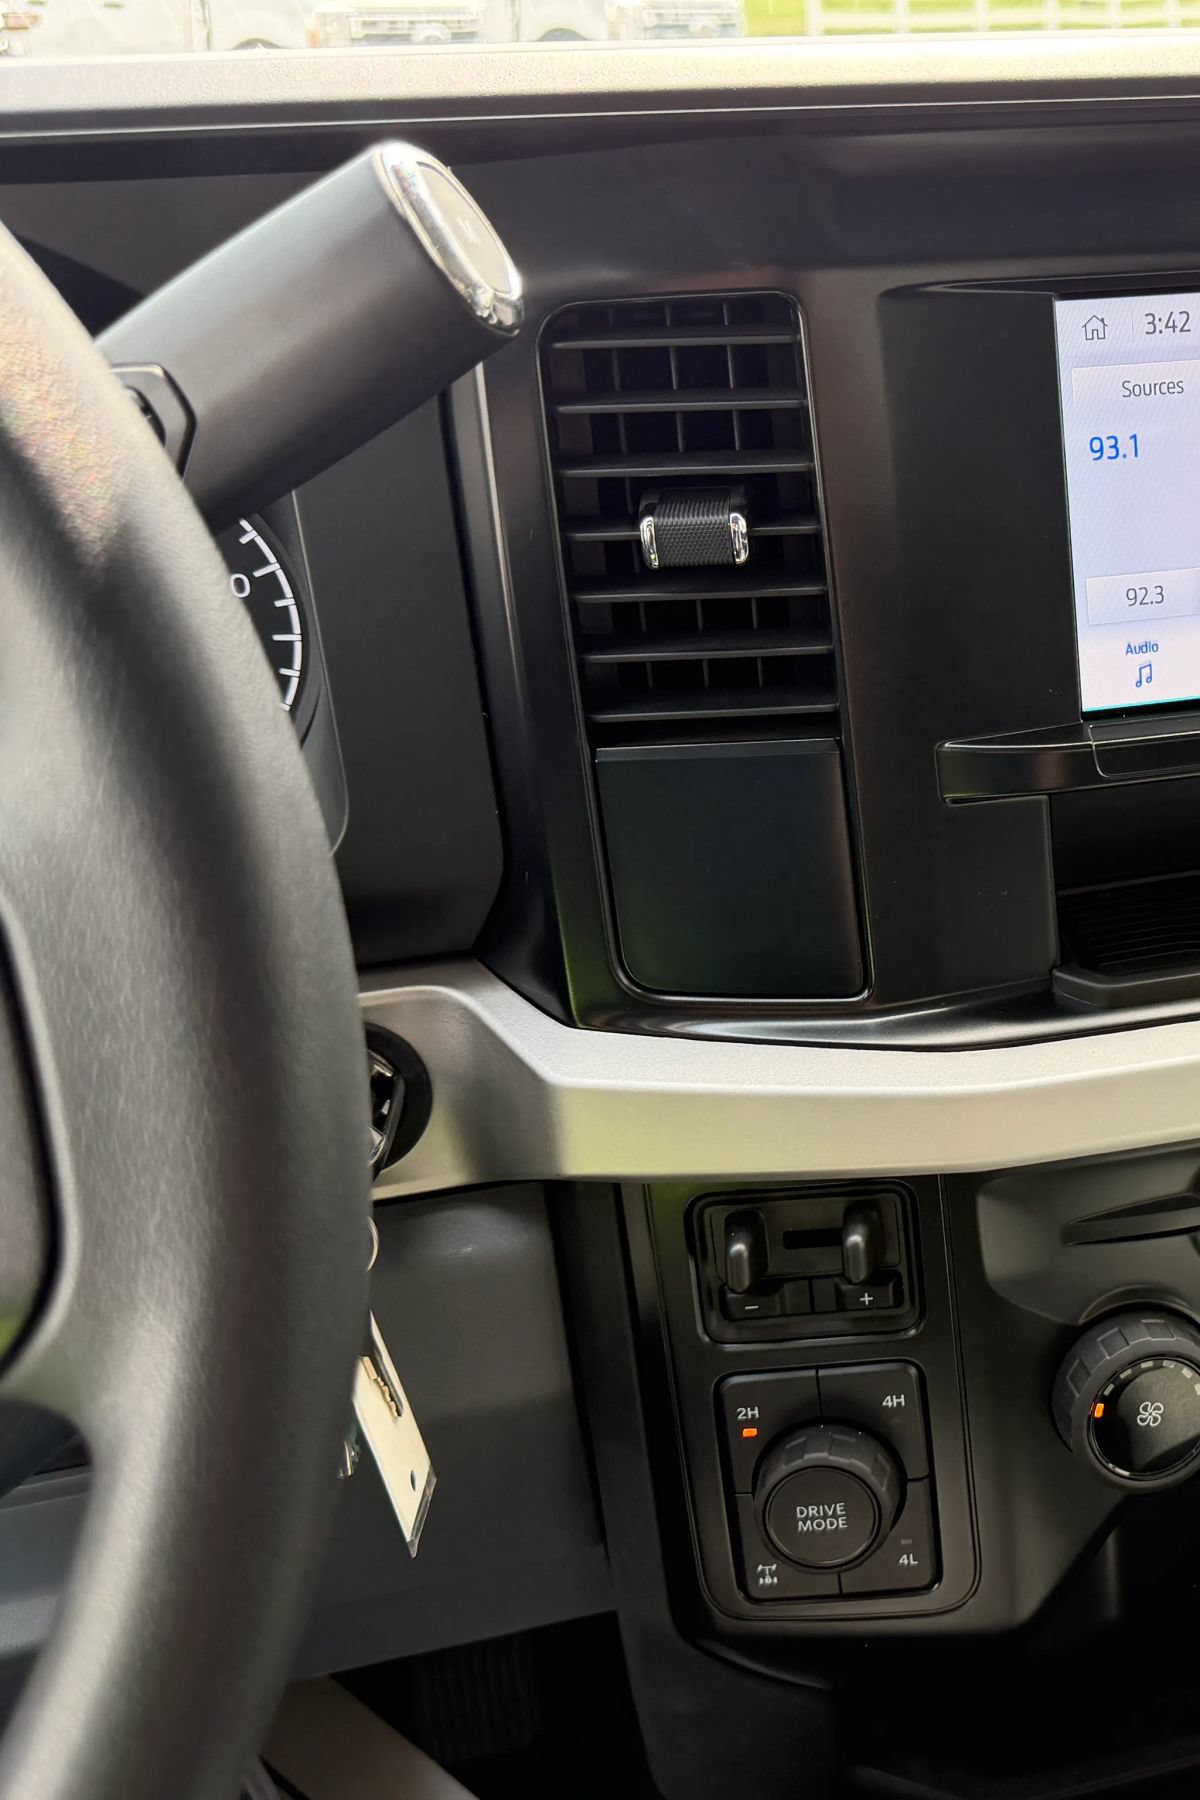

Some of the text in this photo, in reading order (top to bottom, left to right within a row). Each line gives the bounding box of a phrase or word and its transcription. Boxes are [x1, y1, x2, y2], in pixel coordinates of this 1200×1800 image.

[1144, 310, 1192, 336] 3:42
[1121, 376, 1185, 399] Sources
[1088, 434, 1140, 461] 93.1
[1124, 585, 1165, 608] 92.3
[1124, 640, 1160, 658] Audio
[882, 1394, 906, 1408] 4H
[736, 1406, 760, 1420] 2H
[796, 1502, 846, 1519] DRIVE
[798, 1516, 848, 1532] MODE
[899, 1553, 919, 1567] 4L
